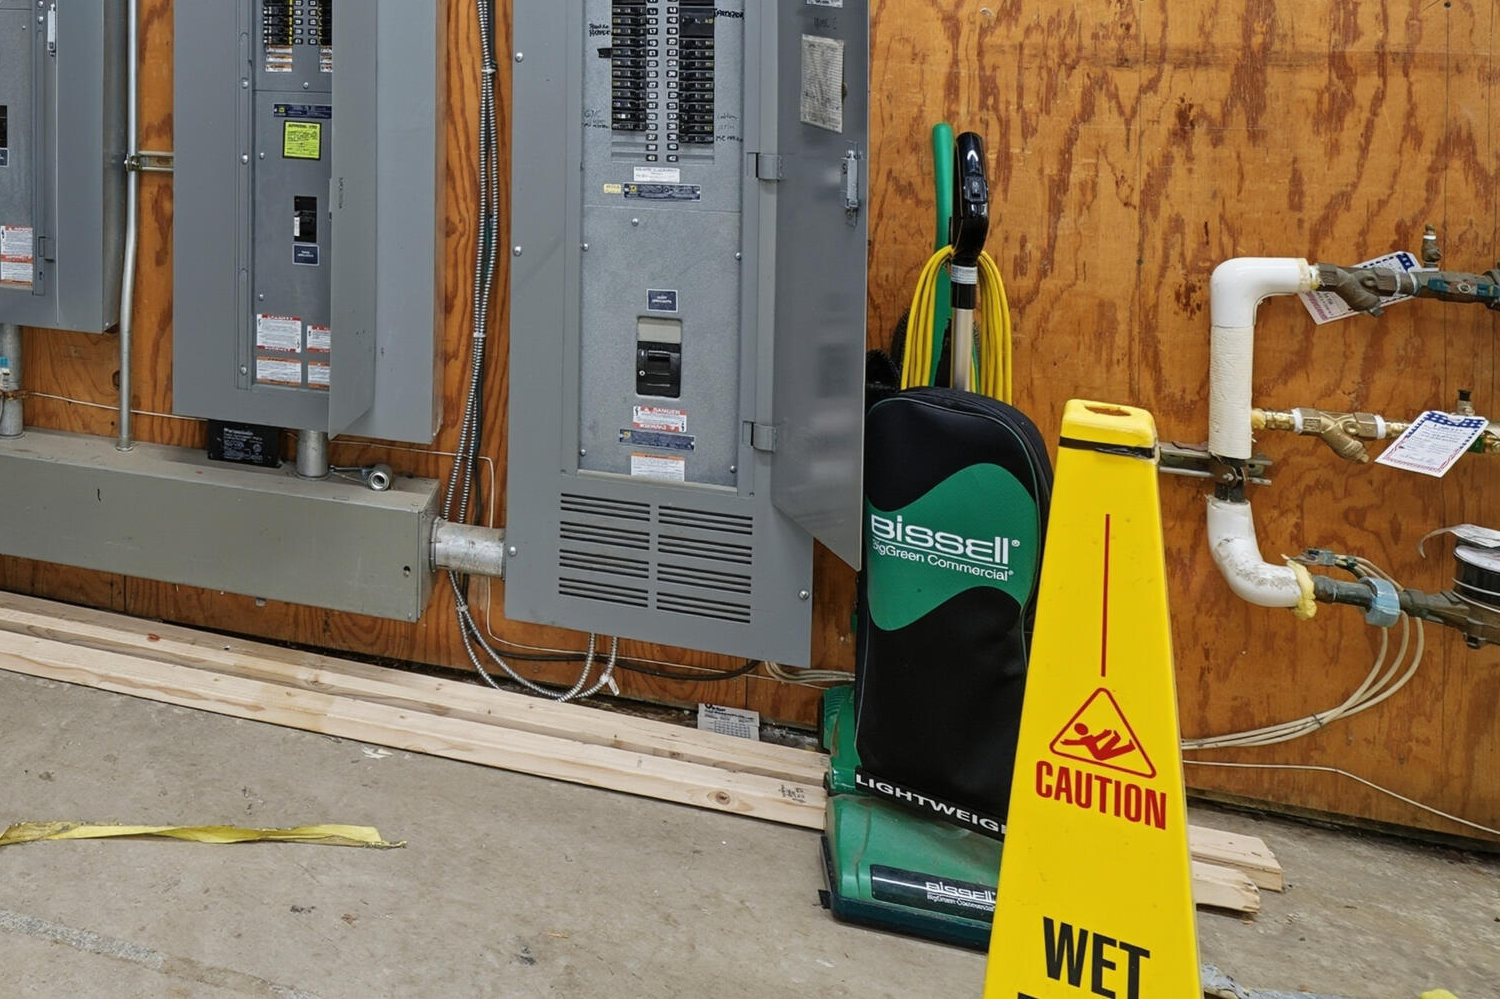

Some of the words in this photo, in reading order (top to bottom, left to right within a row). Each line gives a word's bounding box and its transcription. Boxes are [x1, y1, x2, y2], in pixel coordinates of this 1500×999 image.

[927, 554, 1009, 582] Commercial
[1035, 760, 1166, 830] CAUTION
[1043, 915, 1150, 999] WET
